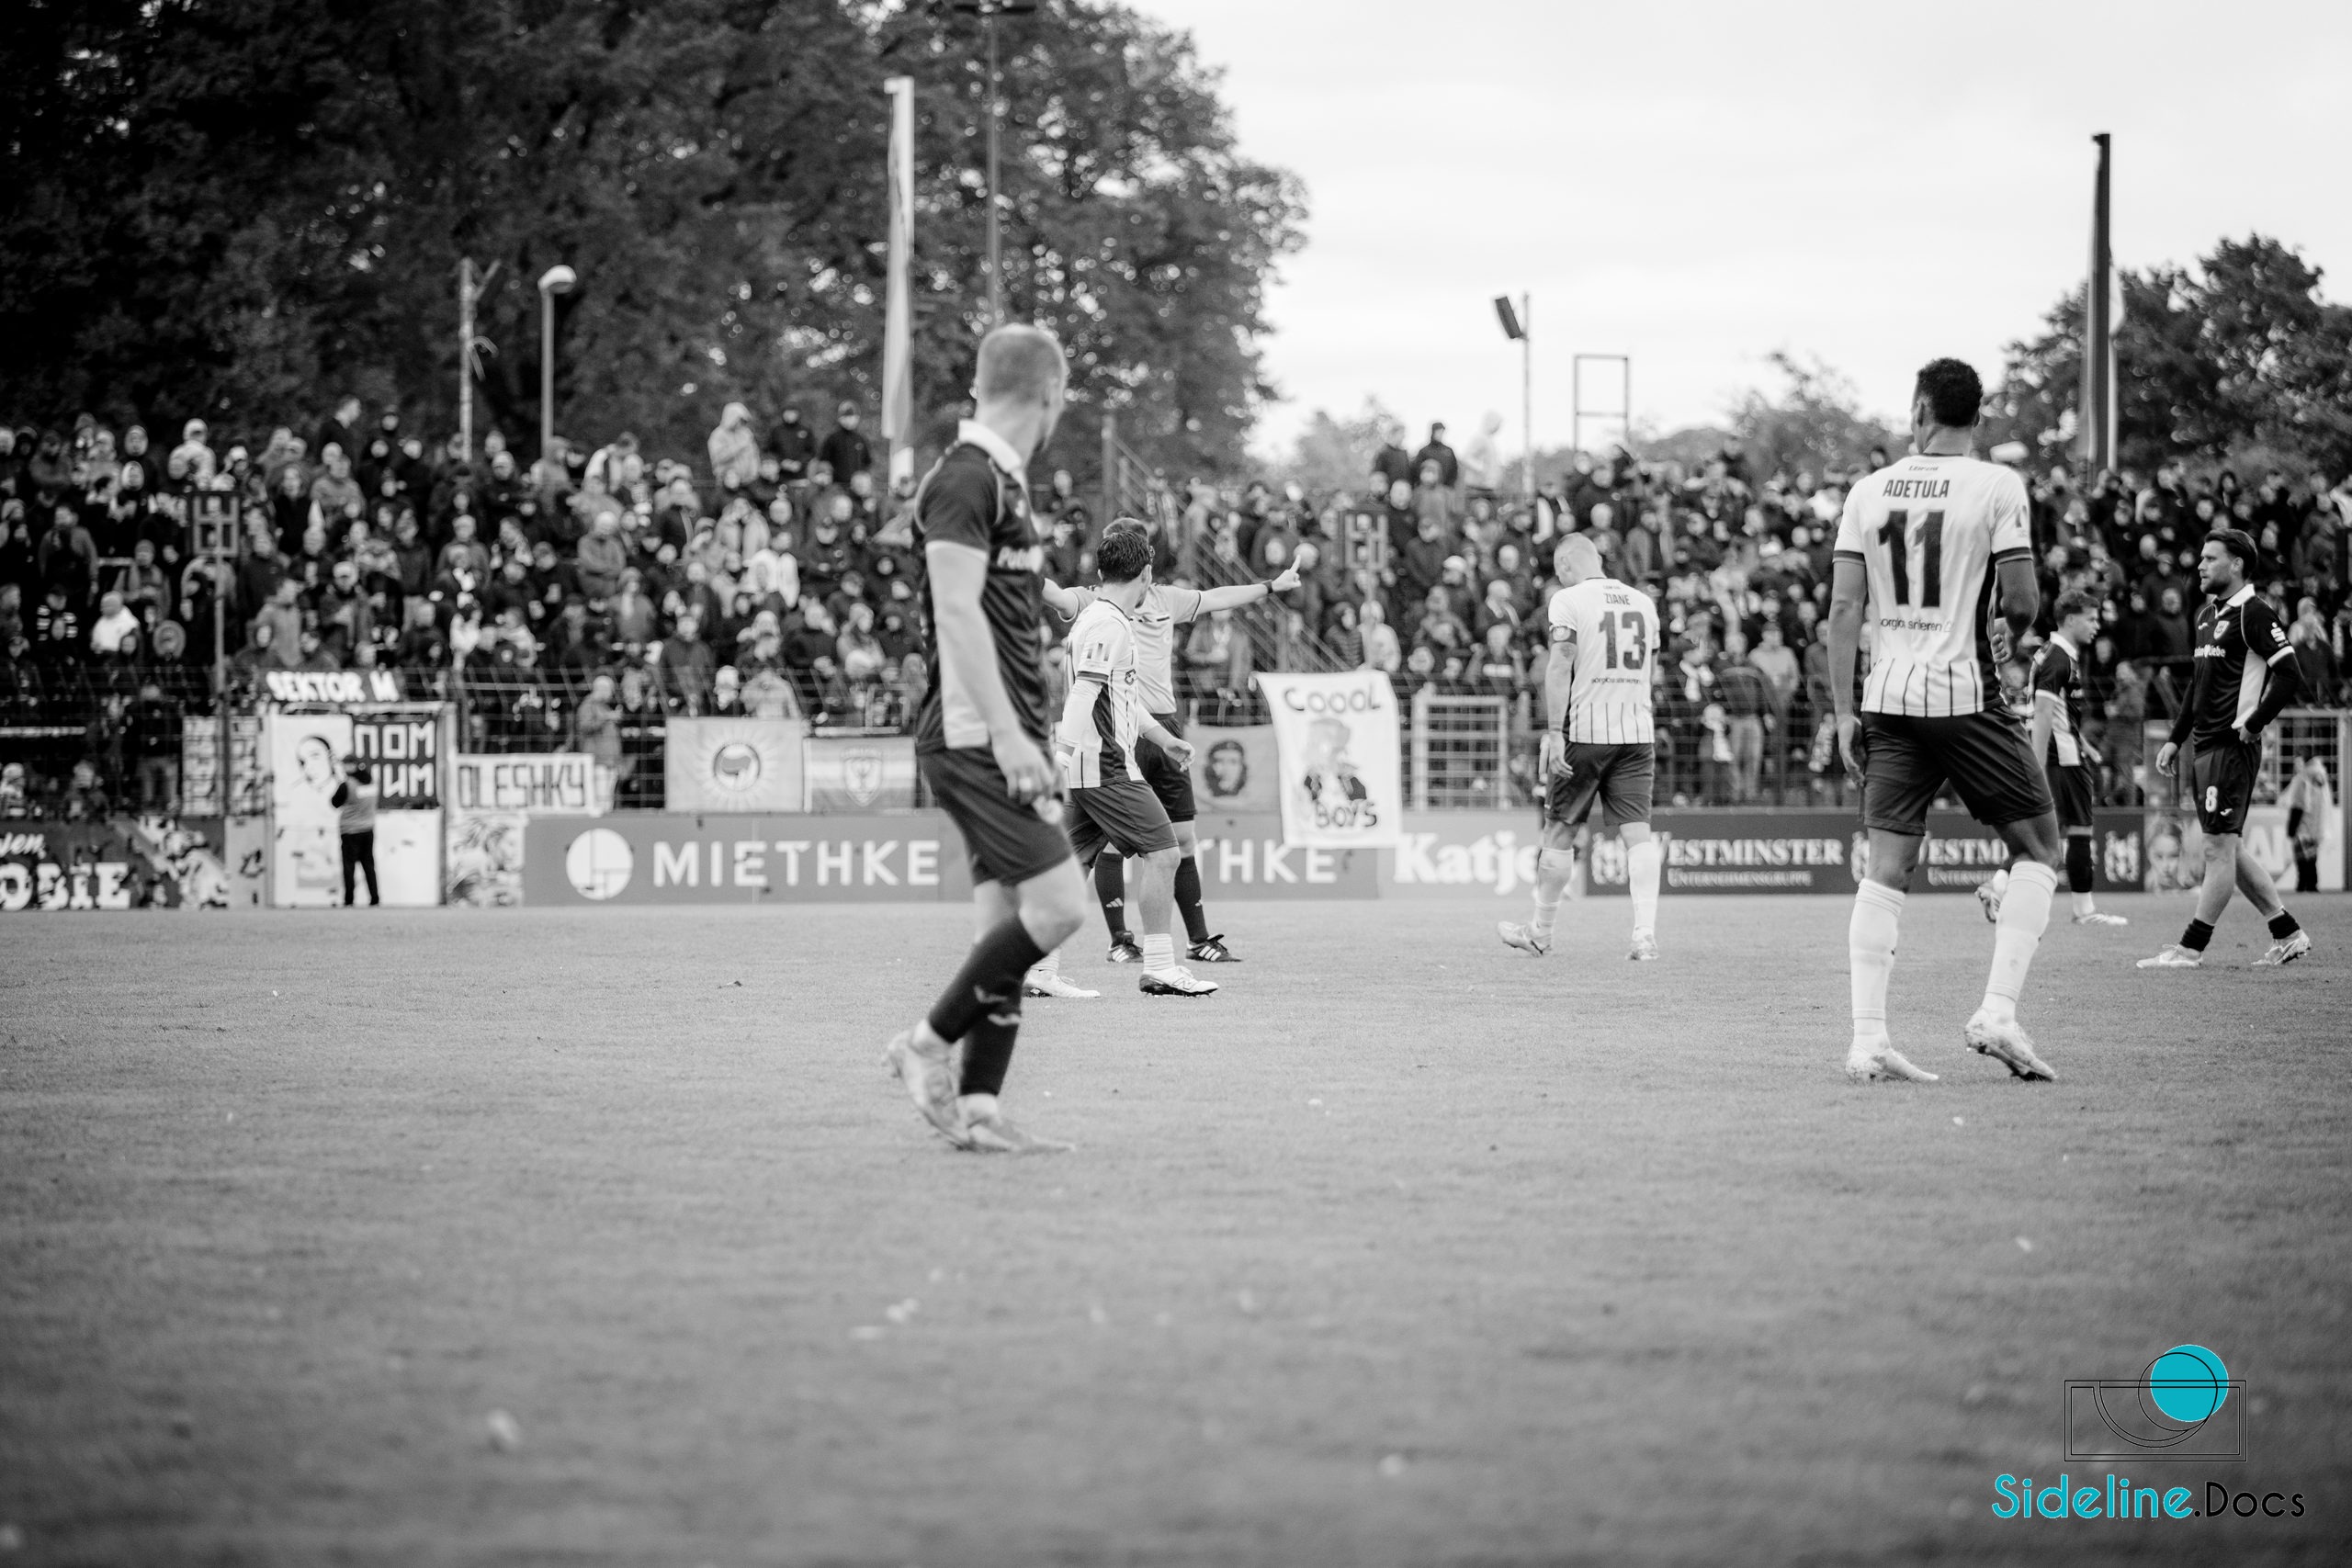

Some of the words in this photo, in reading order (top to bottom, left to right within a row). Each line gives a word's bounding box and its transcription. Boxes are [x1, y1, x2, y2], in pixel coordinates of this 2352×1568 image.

[1883, 479, 1951, 499] ADETULA
[1878, 510, 1945, 608] 11
[1603, 592, 1631, 606] ZIANE
[1599, 611, 1645, 670] 13
[1283, 683, 1382, 714] COOOL
[1316, 798, 1378, 829] BOYS
[2205, 785, 2219, 813] 8
[652, 840, 941, 888] MIETHKE
[1393, 829, 1537, 897] Katje
